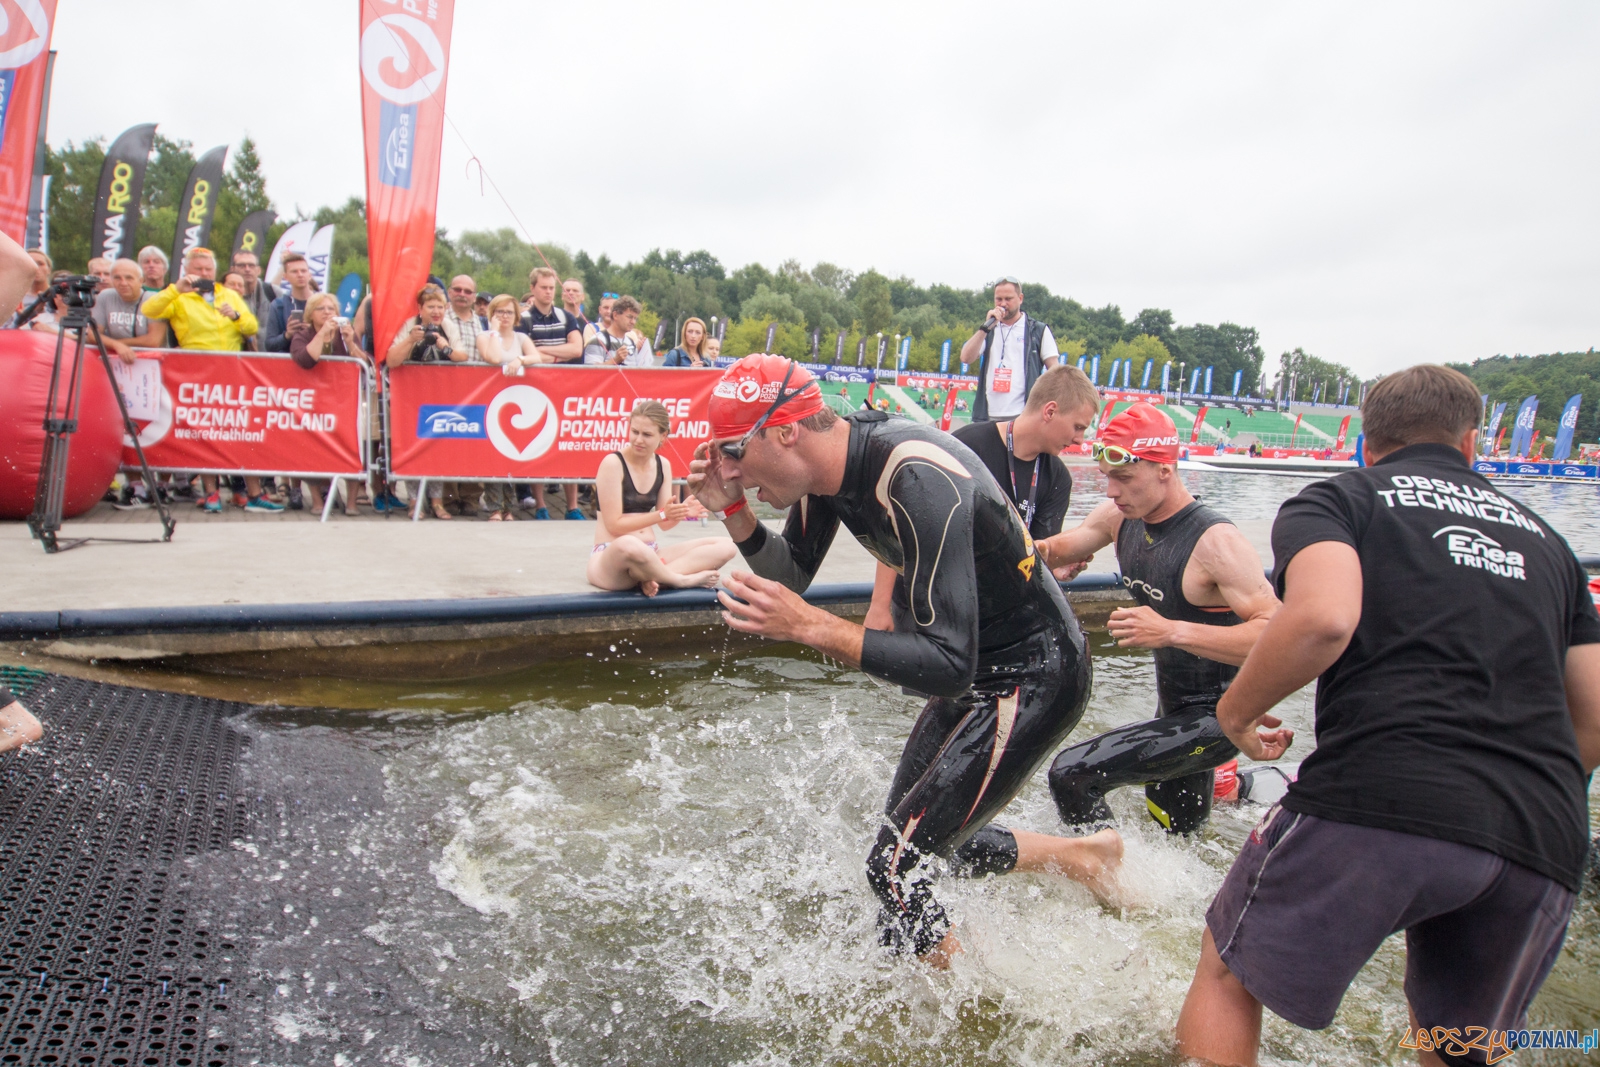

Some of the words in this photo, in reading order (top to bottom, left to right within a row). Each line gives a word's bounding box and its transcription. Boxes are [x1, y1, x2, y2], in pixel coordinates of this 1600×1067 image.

[394, 113, 409, 169] Enea
[107, 162, 132, 213] ROO
[187, 179, 209, 224] ROO
[178, 383, 315, 409] CHALLENGE
[563, 397, 691, 417] CHALLGE
[175, 406, 249, 427] POZNAŃ
[266, 411, 336, 431] POLAND
[432, 418, 479, 433] Enea
[559, 417, 628, 438] POZNAŃ
[667, 421, 710, 438] LAND
[1520, 406, 1531, 426] Enea
[174, 428, 265, 442] wearetriathlon!
[558, 439, 631, 451] wearetriathlo
[1132, 436, 1178, 447] FINIS
[1391, 475, 1519, 513] OBSŁUGA
[1377, 489, 1546, 539] TECHNICZNA
[1448, 534, 1525, 567] Enea
[1450, 552, 1527, 581] TRITOUR
[1122, 575, 1164, 602] orca
